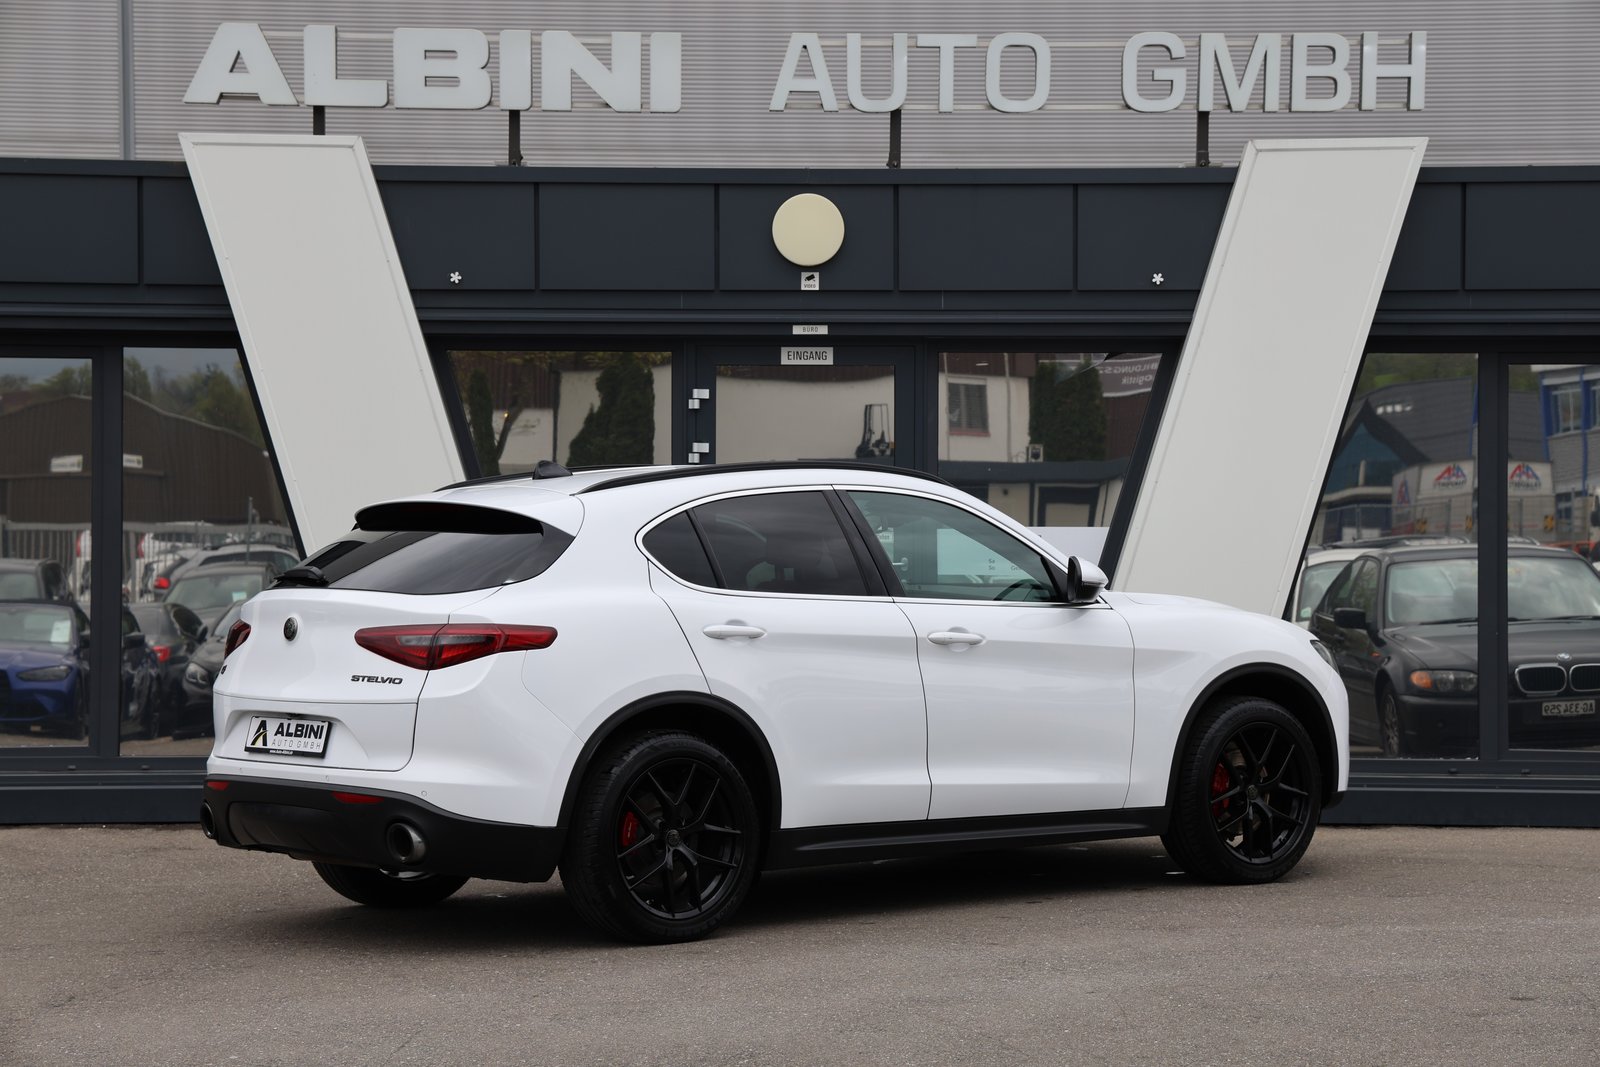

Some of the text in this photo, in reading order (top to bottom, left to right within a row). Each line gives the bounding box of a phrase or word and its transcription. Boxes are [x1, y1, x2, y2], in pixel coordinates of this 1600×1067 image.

[183, 22, 1428, 113] ALBINI AUTO GMBH
[787, 350, 828, 361] EINGANG
[351, 674, 403, 685] STELVIO
[274, 722, 325, 740] ALBINI
[271, 738, 321, 749] AUTO GMBH
